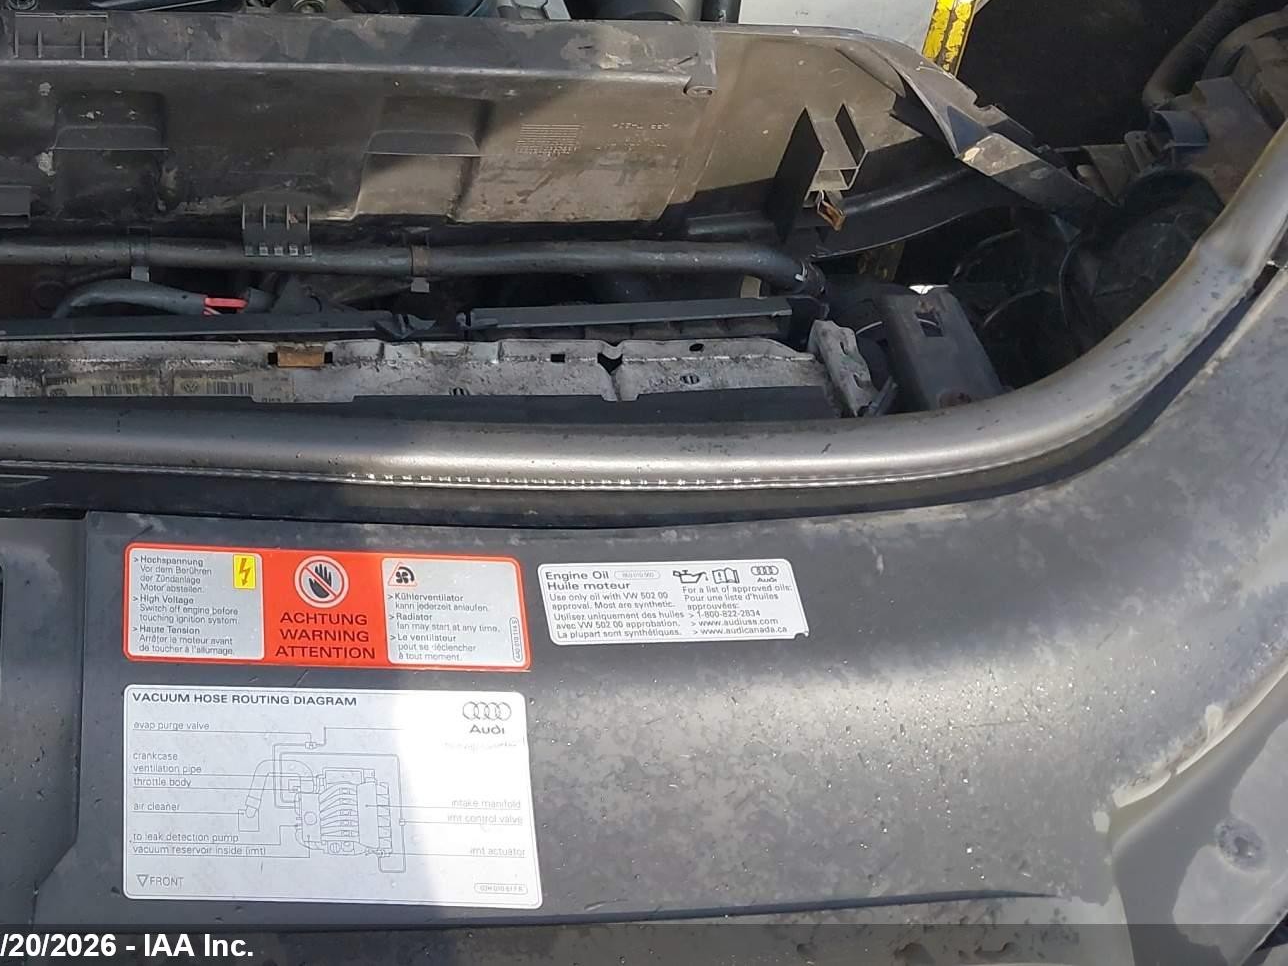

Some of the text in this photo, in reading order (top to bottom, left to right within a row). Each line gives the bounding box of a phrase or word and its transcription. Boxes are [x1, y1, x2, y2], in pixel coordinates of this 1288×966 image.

[140, 555, 204, 567] Hochspannung
[546, 571, 588, 581] Engine
[592, 570, 609, 579] Oil
[140, 583, 164, 592] Motor
[548, 581, 631, 591] Huile moteur
[682, 584, 772, 594] For list approved
[140, 594, 194, 605] High Voltage
[549, 593, 567, 602] Use
[569, 593, 587, 603] only
[590, 592, 600, 601] oil
[602, 592, 621, 601] with
[684, 594, 704, 602] Pour
[140, 603, 238, 615] Switch off engine before
[594, 601, 616, 610] Most
[139, 613, 206, 624] touching ignition
[279, 612, 368, 626] ACHTUNG
[396, 612, 433, 621] Radiator
[139, 625, 201, 635] Haute Tension
[578, 621, 593, 629] VW
[279, 628, 369, 643] WARNING
[275, 645, 376, 659] ATTENTION
[132, 693, 357, 707] VACUUM HOSE ROUTING DIAGRAM
[158, 721, 210, 731] purge valve
[469, 724, 505, 735] Audi
[133, 751, 178, 761] crankcase
[133, 764, 202, 775] ventilation pipe
[133, 777, 192, 788] throttle body
[133, 802, 180, 811] air cleaner
[144, 833, 239, 844] leak detection pump
[133, 845, 242, 856] vacuum reservoir inside
[149, 875, 184, 886] FRONT
